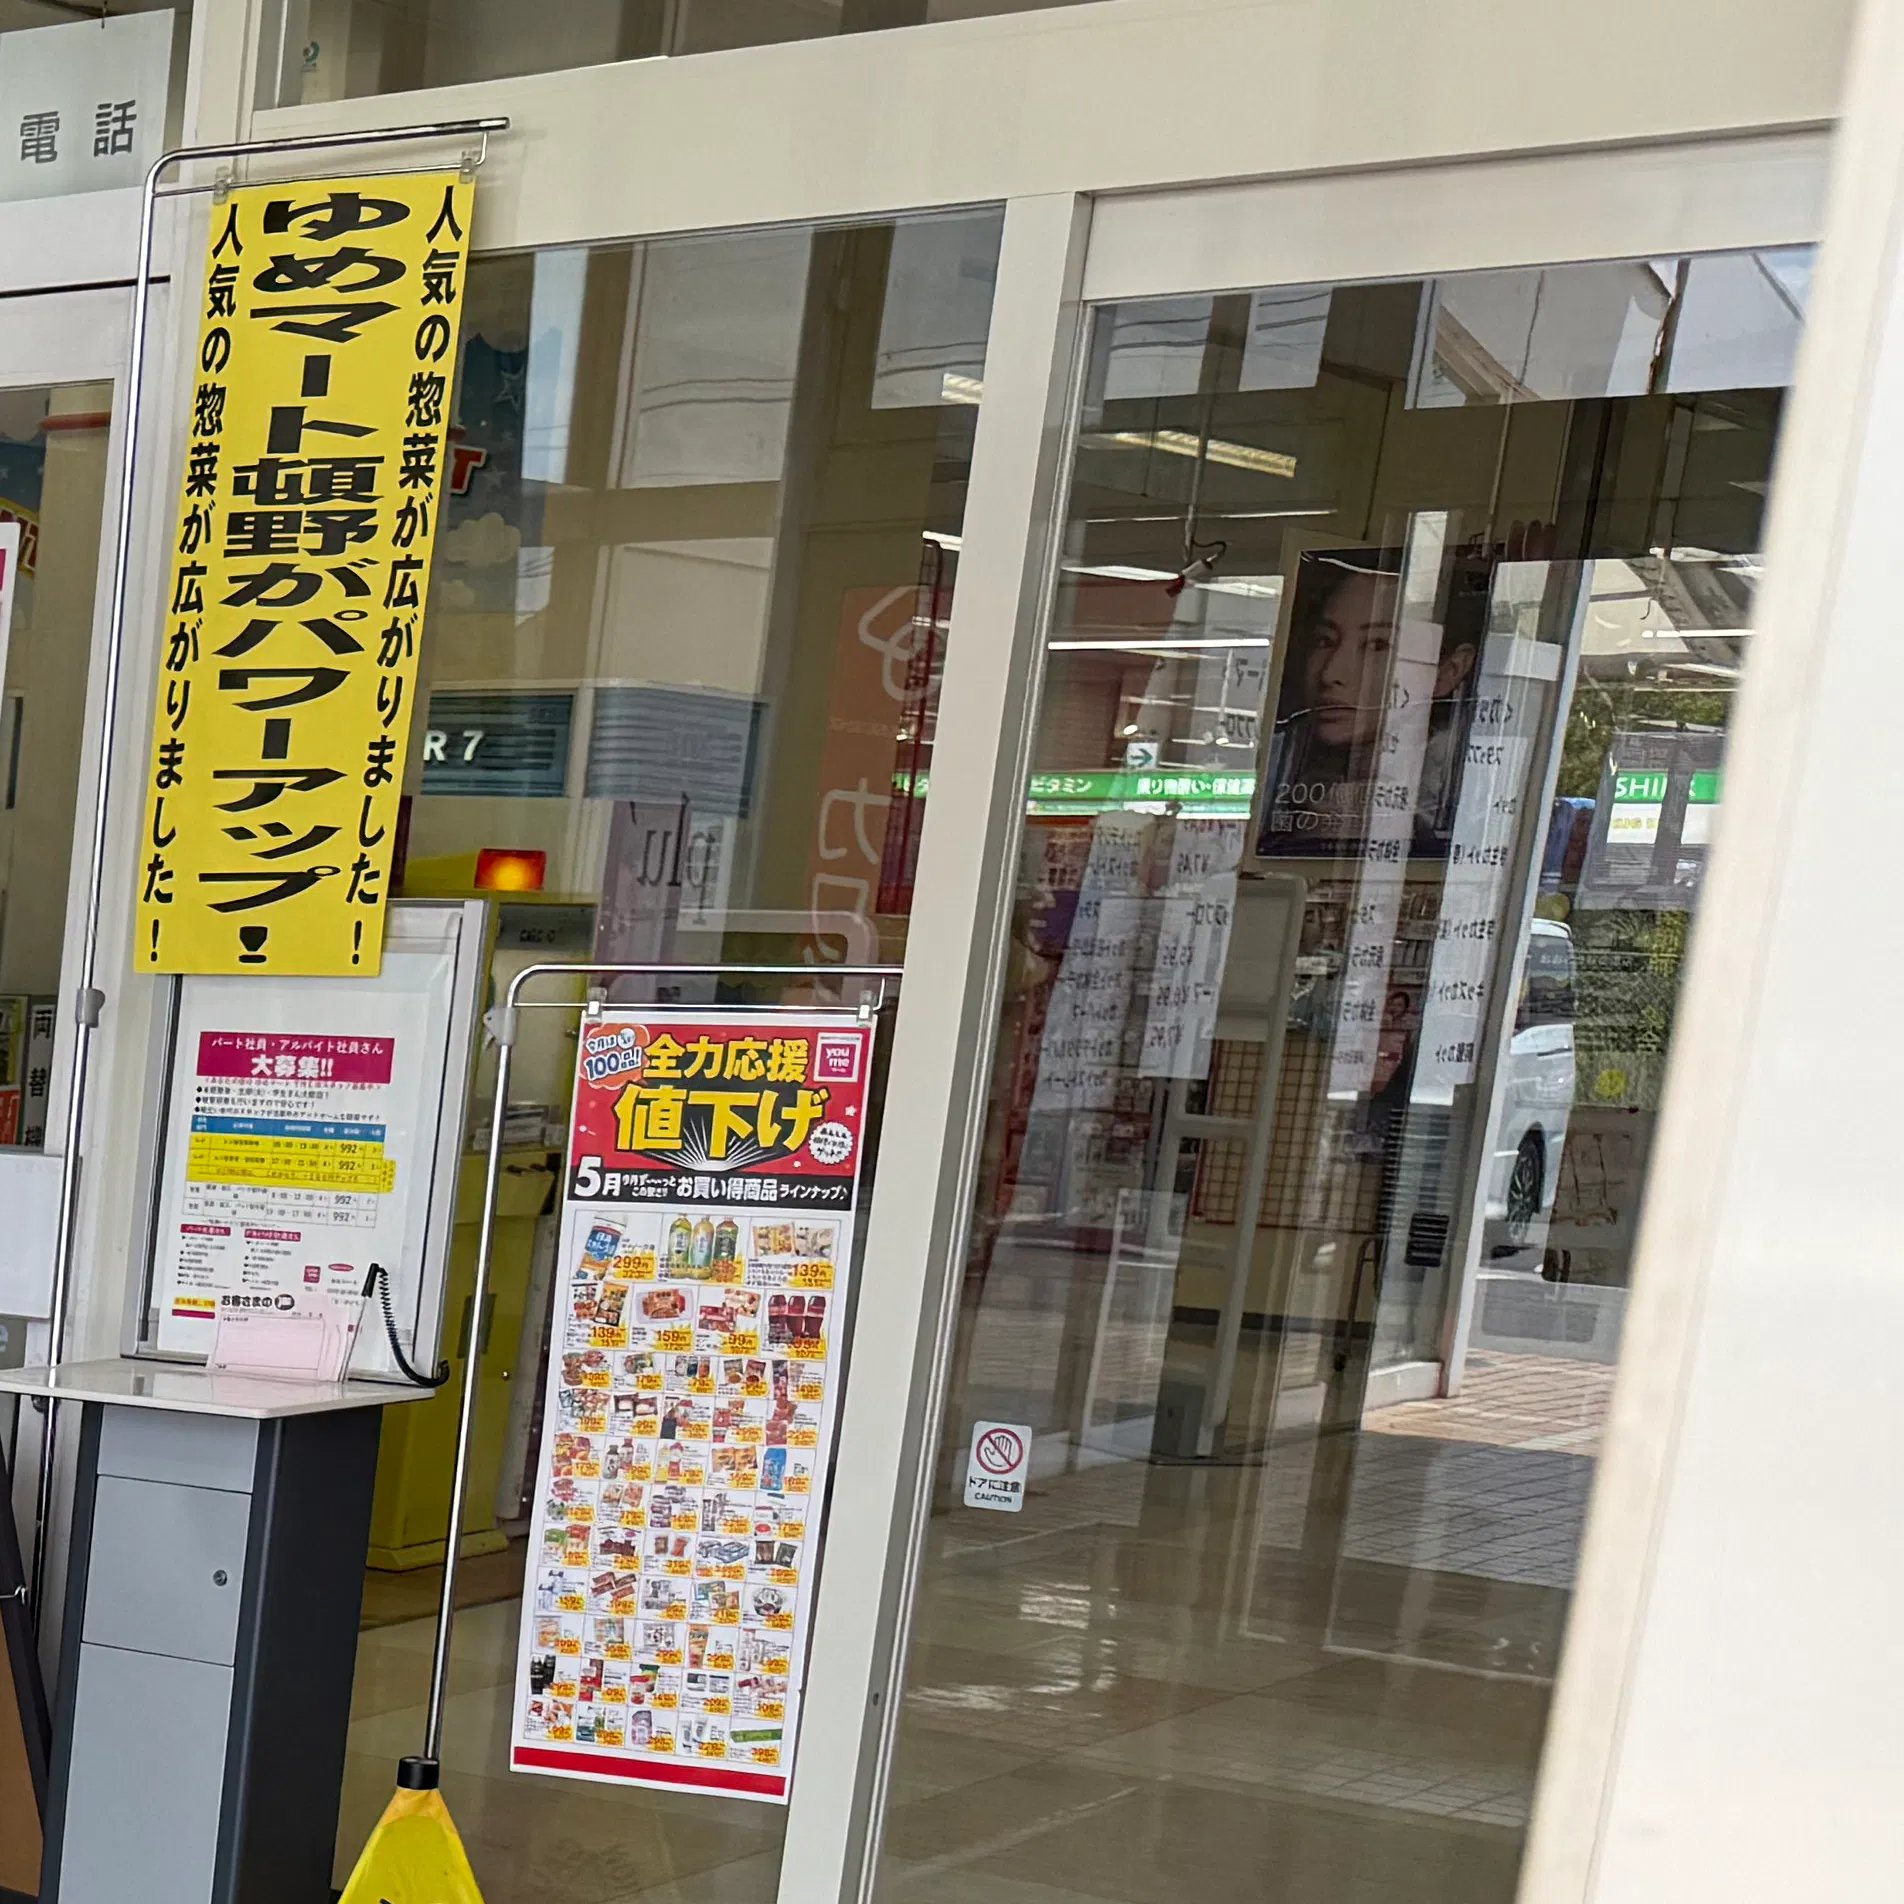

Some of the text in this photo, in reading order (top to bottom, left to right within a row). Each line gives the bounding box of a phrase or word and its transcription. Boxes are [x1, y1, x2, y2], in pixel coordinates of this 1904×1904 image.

[18, 99, 139, 165] 電話
[643, 1033, 810, 1085] 全力応援
[614, 1083, 831, 1160] 値下げ
[574, 1155, 622, 1198] 5月
